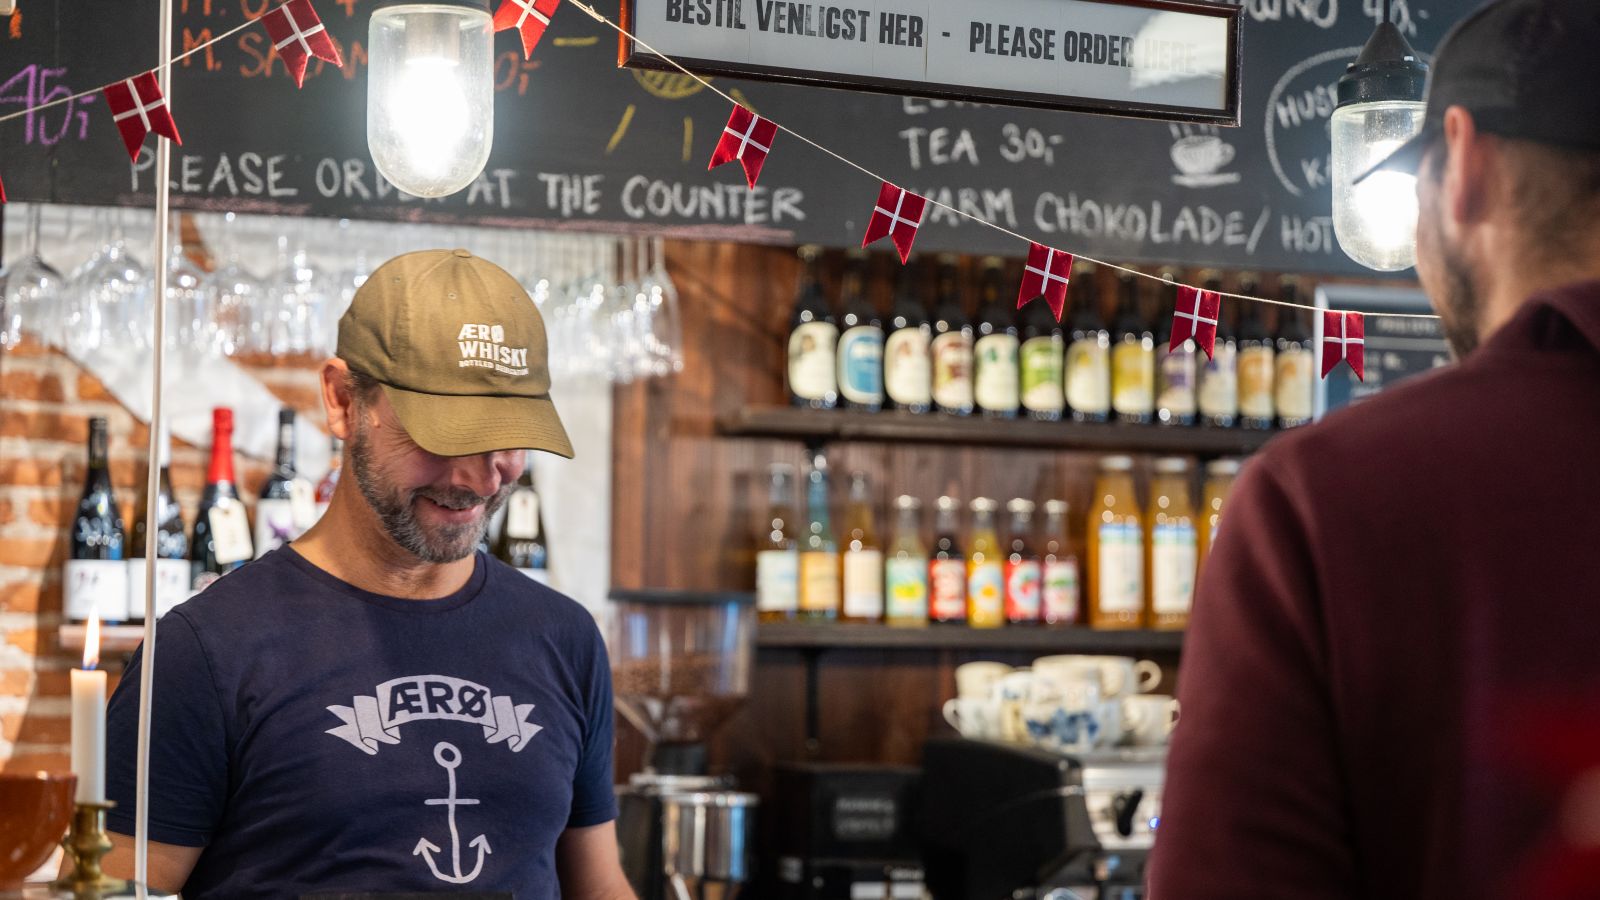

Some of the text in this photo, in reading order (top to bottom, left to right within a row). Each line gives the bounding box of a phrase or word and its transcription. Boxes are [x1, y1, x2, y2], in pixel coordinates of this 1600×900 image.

[665, 0, 747, 30] BESTIL
[756, 0, 870, 42] VENLIGST
[879, 11, 924, 48] HER
[970, 21, 1056, 60] PLEASE
[1064, 30, 1136, 67] ORDER
[1275, 82, 1339, 129] HUS
[899, 126, 980, 170] TEA
[131, 147, 299, 197] PEASE
[315, 157, 446, 203] ORD
[537, 172, 604, 217] THE
[621, 174, 806, 225] COUNTER
[458, 341, 528, 367] WHISKY
[388, 680, 488, 722] ÆRØ
